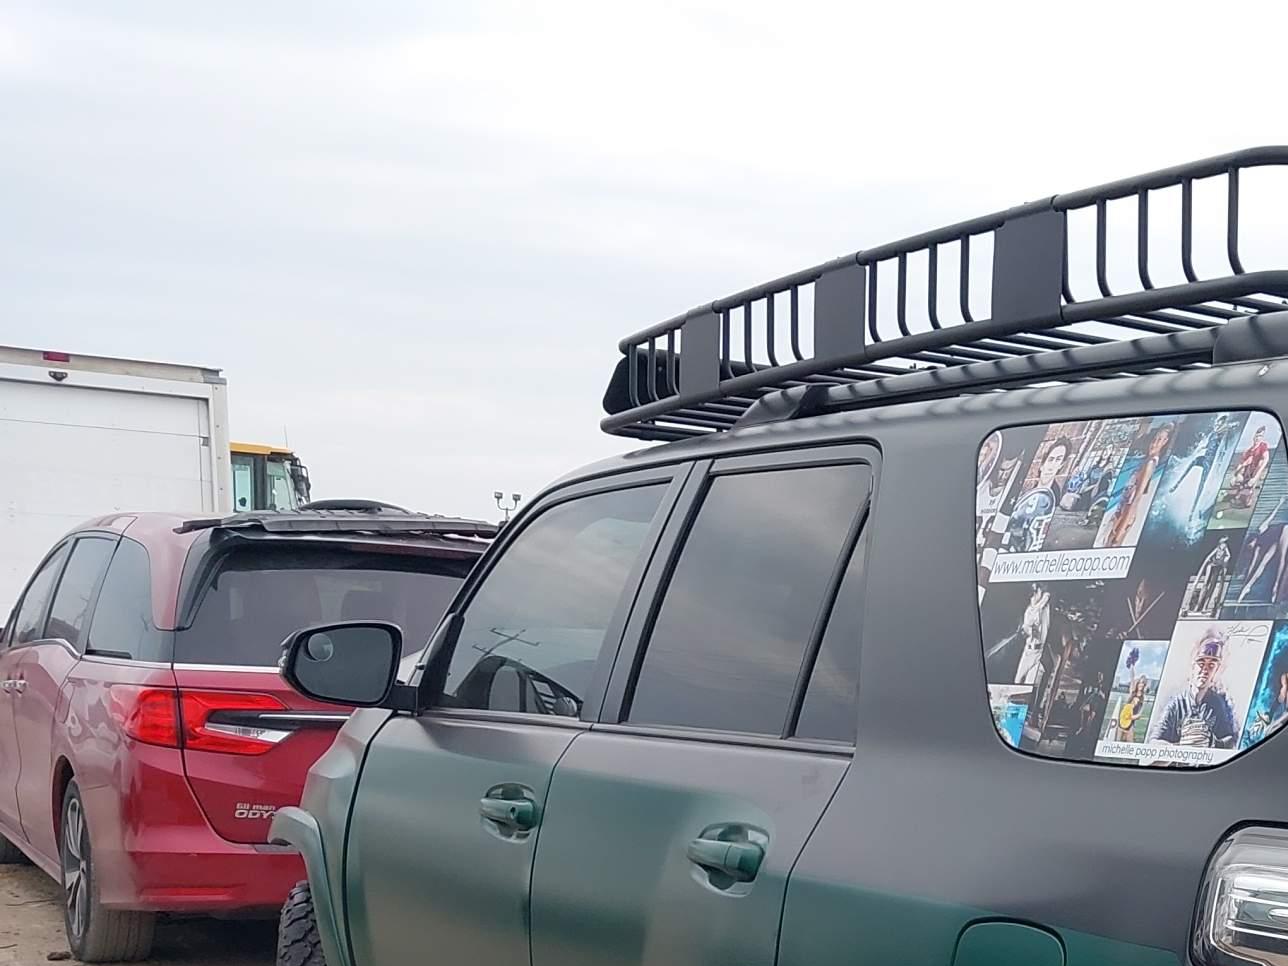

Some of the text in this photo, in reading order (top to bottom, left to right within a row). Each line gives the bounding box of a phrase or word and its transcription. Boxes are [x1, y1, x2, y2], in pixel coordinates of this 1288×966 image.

[994, 553, 1131, 577] www.michellepapp.com
[1102, 744, 1214, 762] michelle papp photography
